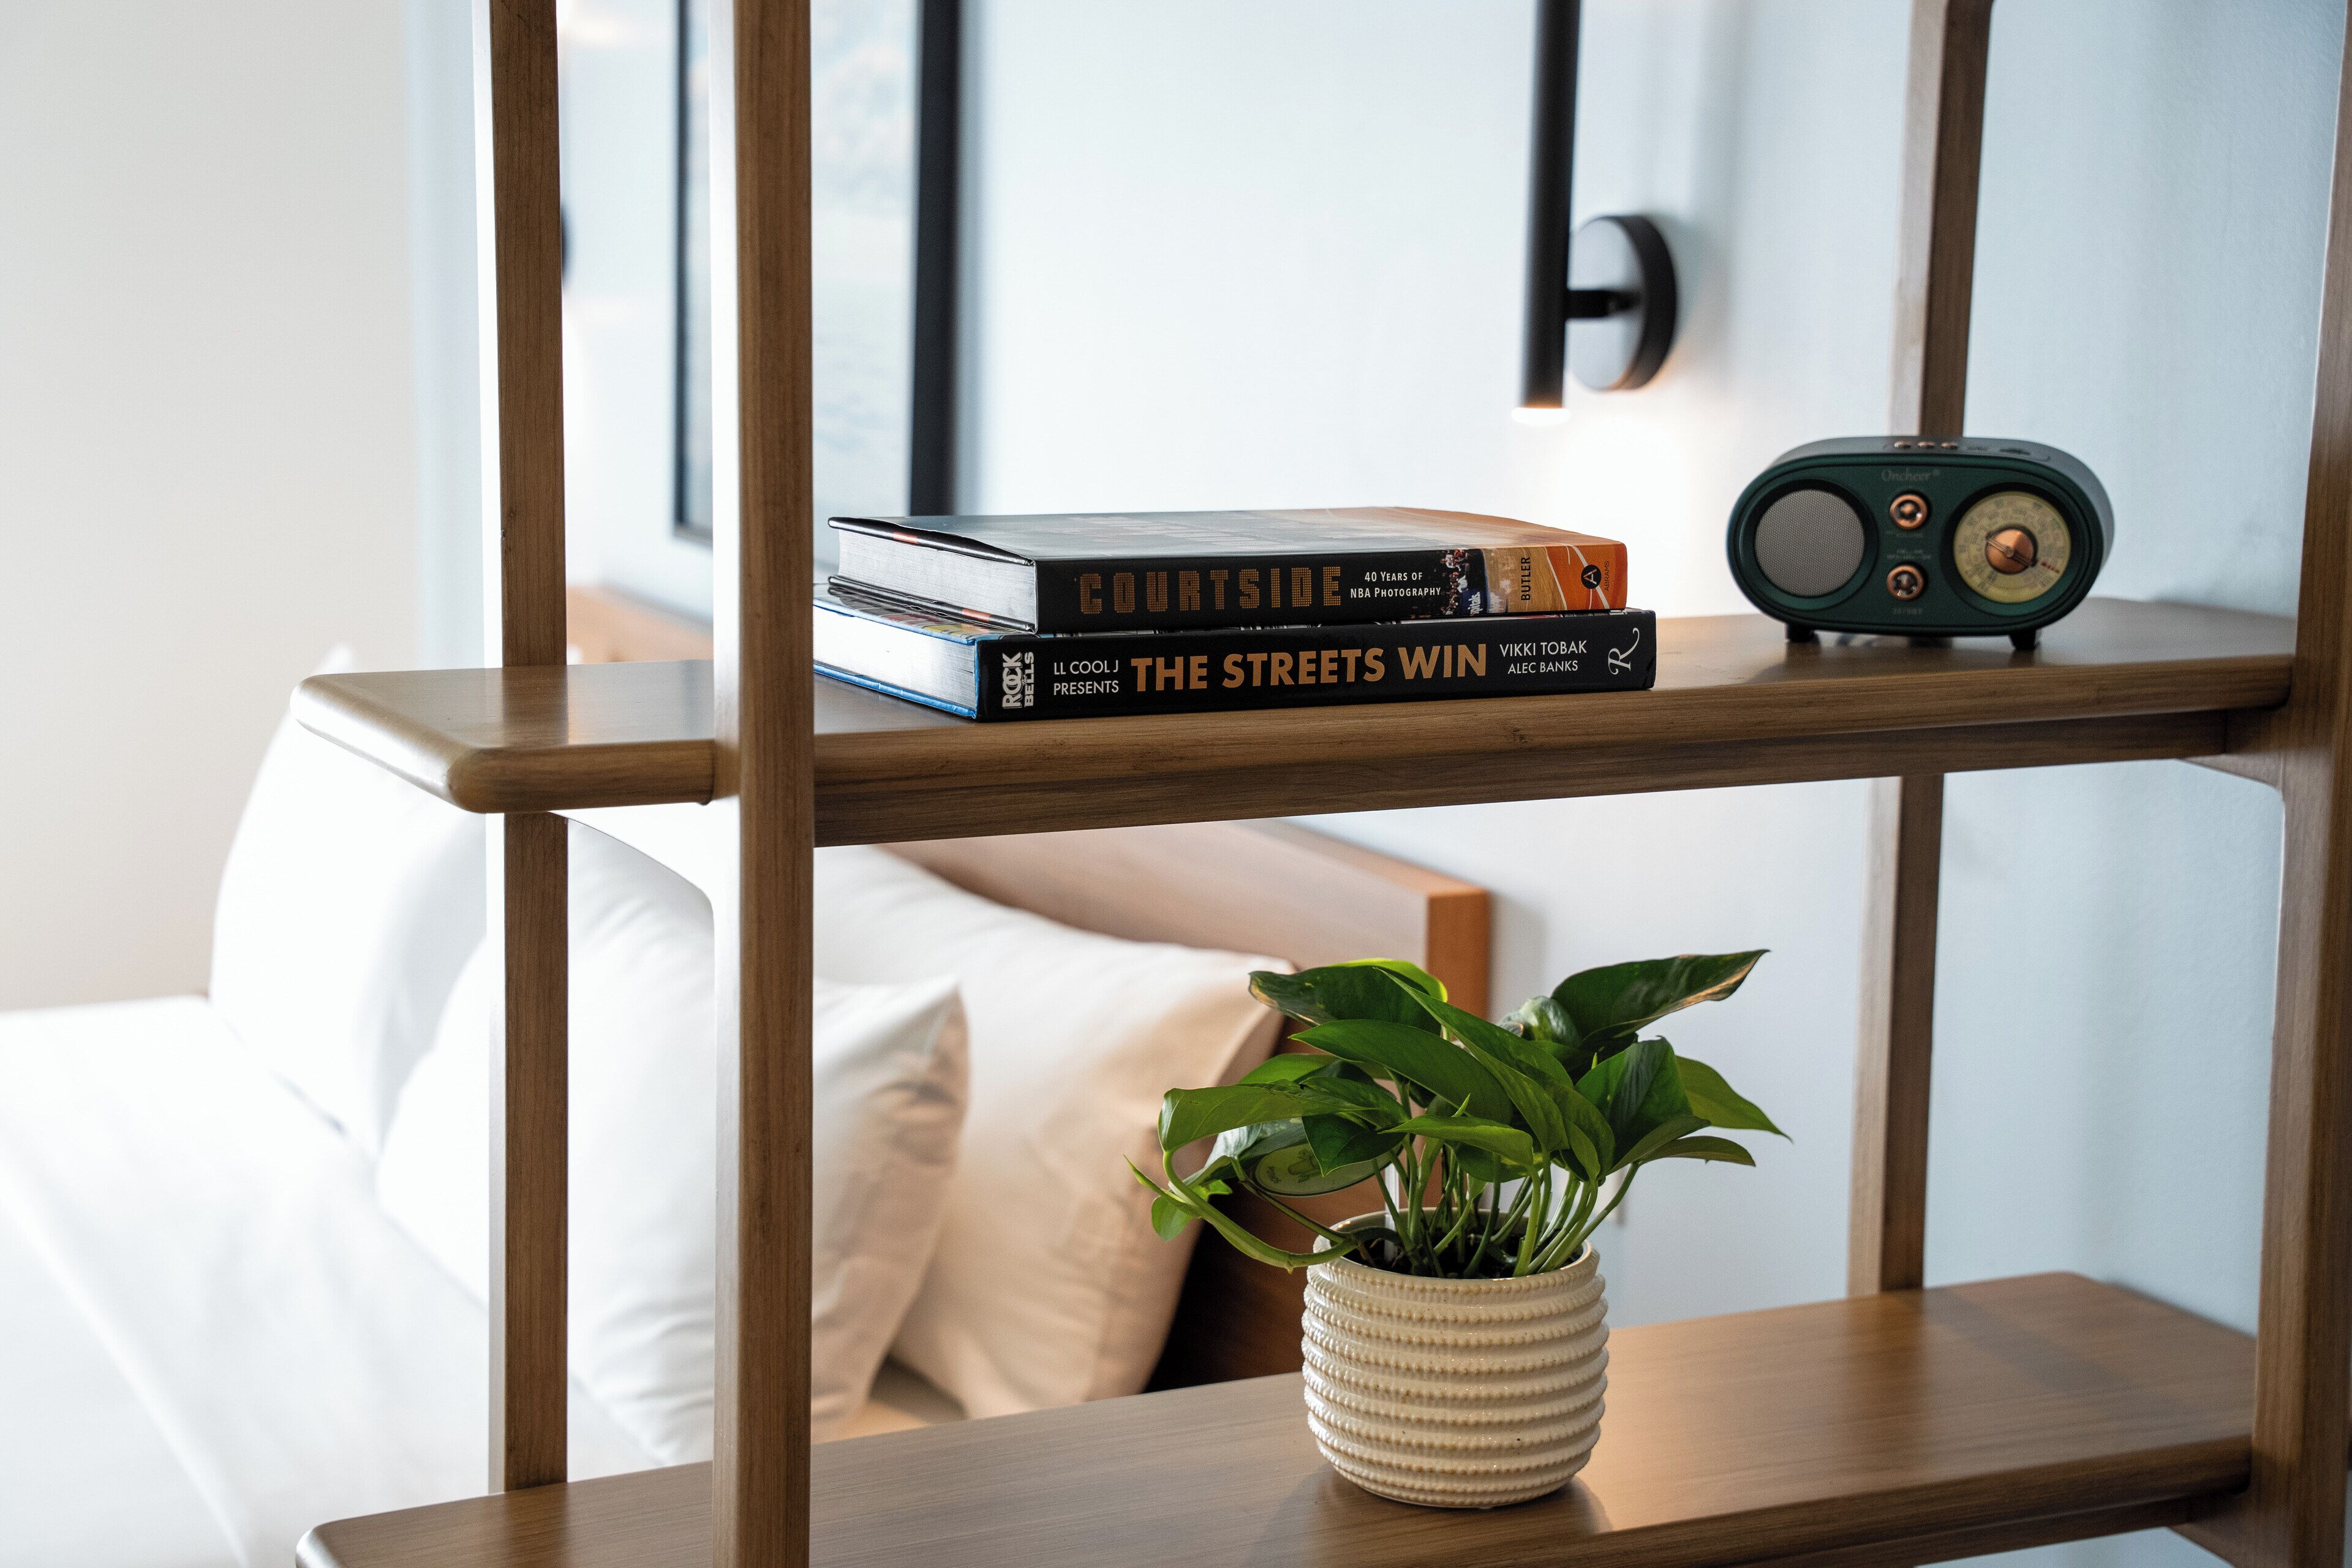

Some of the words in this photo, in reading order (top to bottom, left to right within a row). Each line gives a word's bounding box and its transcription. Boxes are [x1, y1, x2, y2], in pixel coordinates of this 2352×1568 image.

[1365, 571, 1377, 582] 40
[1520, 557, 1531, 600] BUTLER
[1080, 566, 1341, 614] COURTSIDE
[1351, 588, 1371, 598] NBA
[1499, 643, 1536, 657] VIKKI
[1540, 640, 1587, 655] TOBAK
[1054, 662, 1066, 675] LL
[1070, 660, 1110, 674] COOL
[1113, 660, 1118, 673] J
[1131, 655, 1207, 692] THE
[1222, 647, 1385, 688] STREETS
[1398, 644, 1487, 680] WIN
[1507, 662, 1536, 674] ALEC
[1540, 660, 1578, 673] BANKS
[1002, 652, 1022, 709] ROCK
[1024, 652, 1034, 707] BELLS
[1054, 680, 1119, 695] PRESENTS
